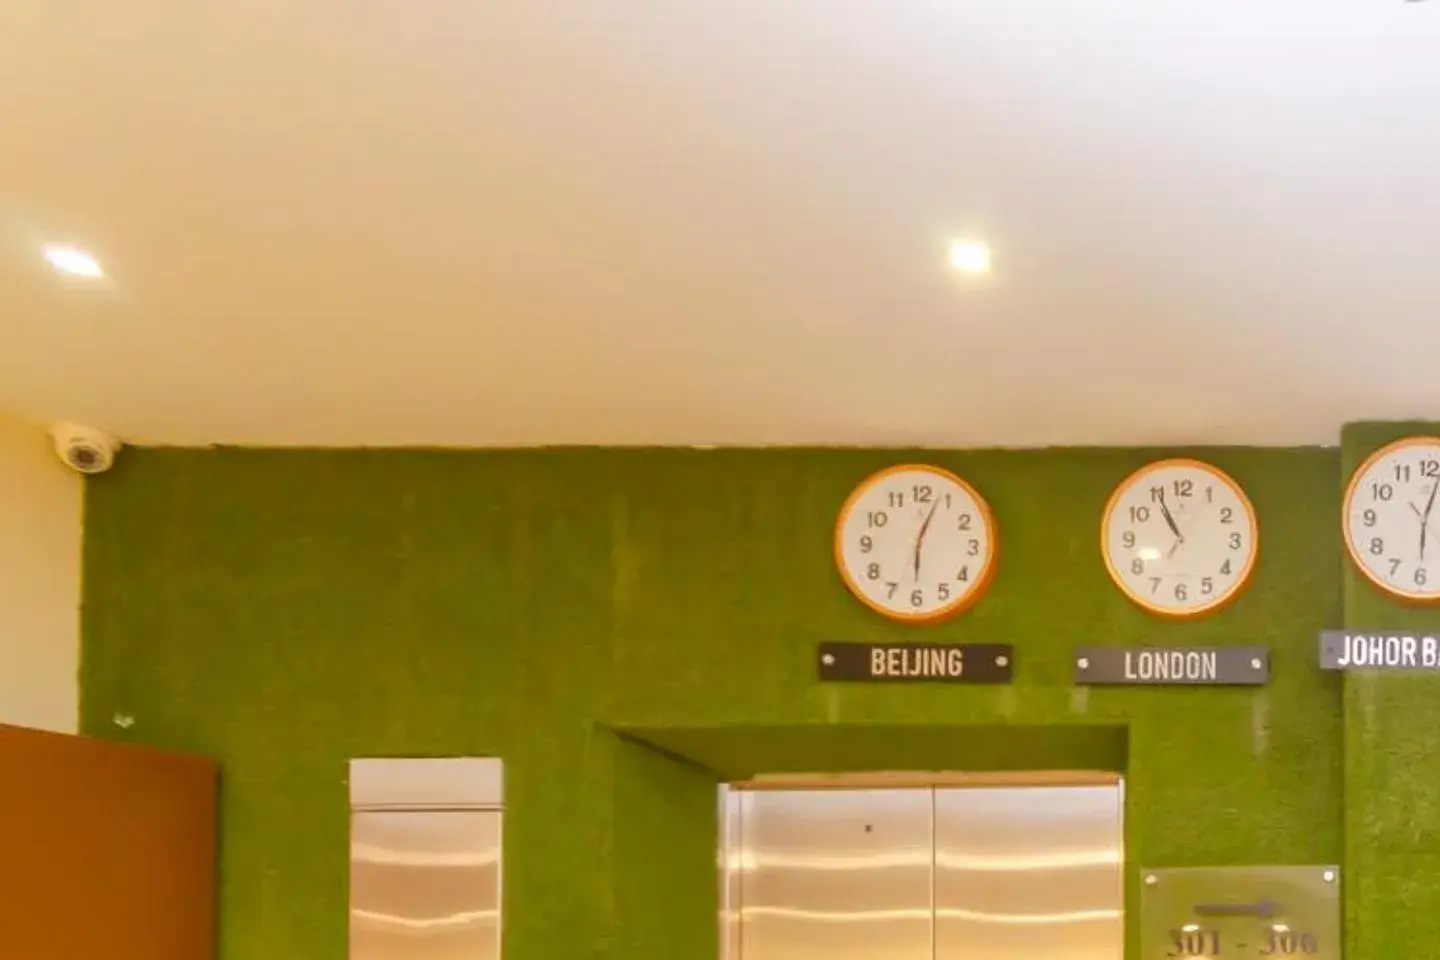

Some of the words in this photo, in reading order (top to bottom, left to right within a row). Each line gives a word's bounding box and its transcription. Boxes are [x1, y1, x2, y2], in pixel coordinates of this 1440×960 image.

[1395, 464, 1410, 483] 11
[1419, 460, 1440, 477] 12
[912, 485, 933, 502] 12
[1150, 486, 1164, 502] 11
[1174, 480, 1193, 497] 12
[1372, 483, 1393, 501] 10
[889, 492, 903, 508] 11
[868, 511, 888, 528] 10
[958, 514, 971, 531] 2
[1129, 506, 1150, 522] 10
[1220, 507, 1232, 524] 2
[1363, 509, 1376, 527] 9
[860, 535, 873, 553] 9
[967, 539, 979, 556] 3
[1122, 530, 1136, 548] 9
[1229, 532, 1242, 550] 3
[1370, 537, 1383, 555] 8
[867, 563, 880, 580] 8
[956, 565, 969, 582] 4
[1131, 558, 1144, 575] 8
[1219, 559, 1232, 575] 4
[1388, 558, 1402, 576] 7
[1148, 577, 1162, 594] 7
[1201, 577, 1213, 594] 5
[1413, 568, 1426, 586] 6
[886, 582, 898, 599] 7
[910, 589, 923, 607] 6
[938, 583, 950, 601] 5
[1174, 584, 1187, 601] 6
[1337, 636, 1416, 667] JOHOR
[870, 647, 963, 679] BEIJING
[1124, 650, 1217, 681] LONDON
